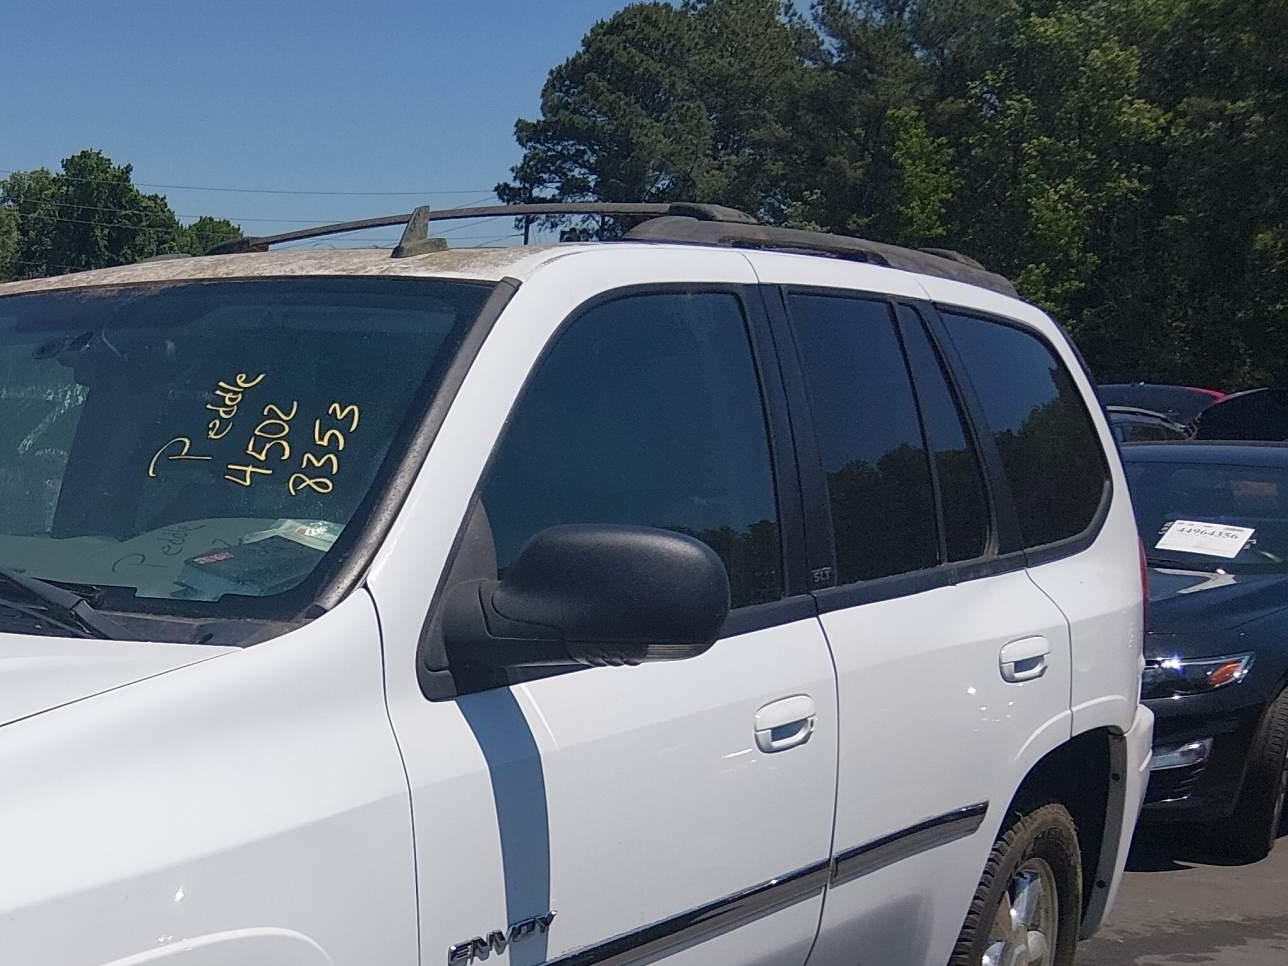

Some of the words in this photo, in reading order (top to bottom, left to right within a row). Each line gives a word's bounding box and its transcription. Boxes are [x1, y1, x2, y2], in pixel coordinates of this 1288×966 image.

[149, 372, 265, 477] Peddle
[225, 401, 297, 486] 4502
[288, 402, 360, 496] 8353
